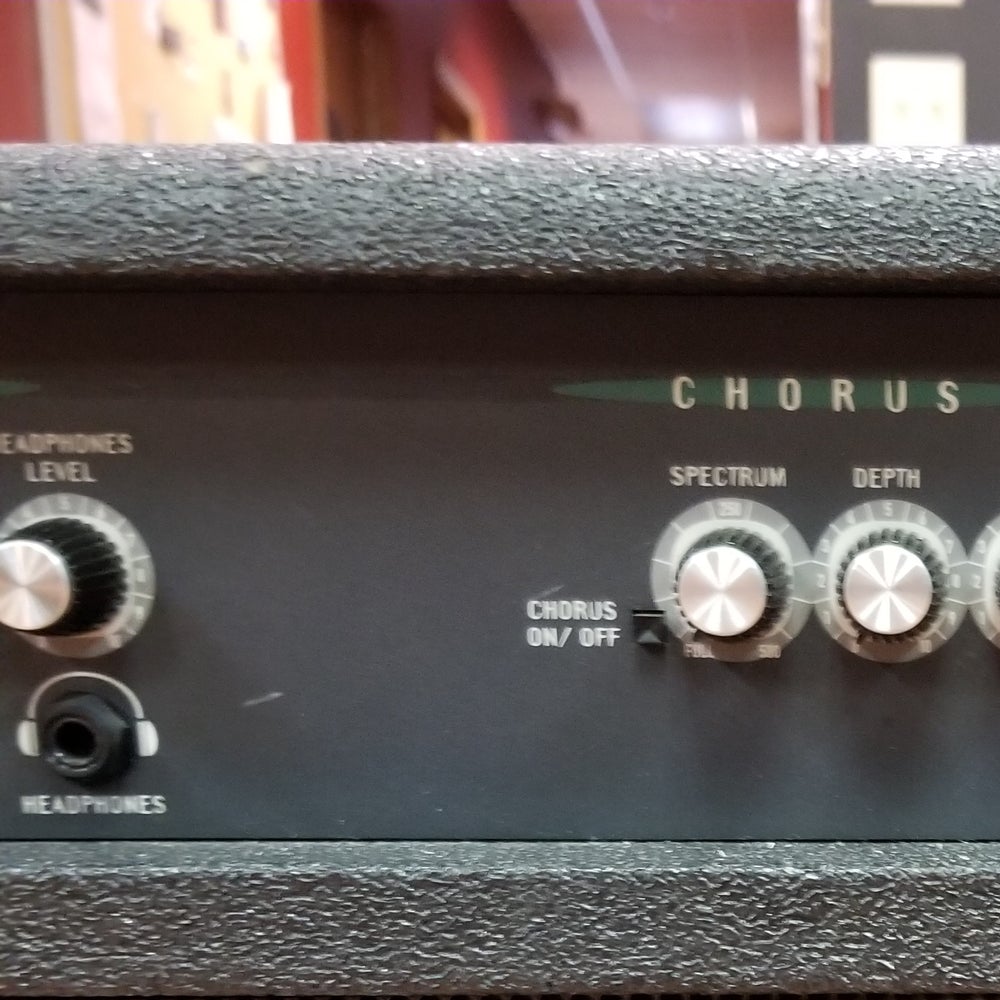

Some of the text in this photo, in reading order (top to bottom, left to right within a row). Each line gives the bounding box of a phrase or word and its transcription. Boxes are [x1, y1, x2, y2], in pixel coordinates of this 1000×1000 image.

[671, 376, 960, 414] CHORUS
[24, 461, 98, 483] LEVEL
[669, 466, 787, 487] SPECTRUM
[852, 467, 921, 489] DEPTH
[526, 600, 618, 620] CHORUS
[578, 627, 621, 647] OFF
[20, 795, 168, 815] HEADPHONES
